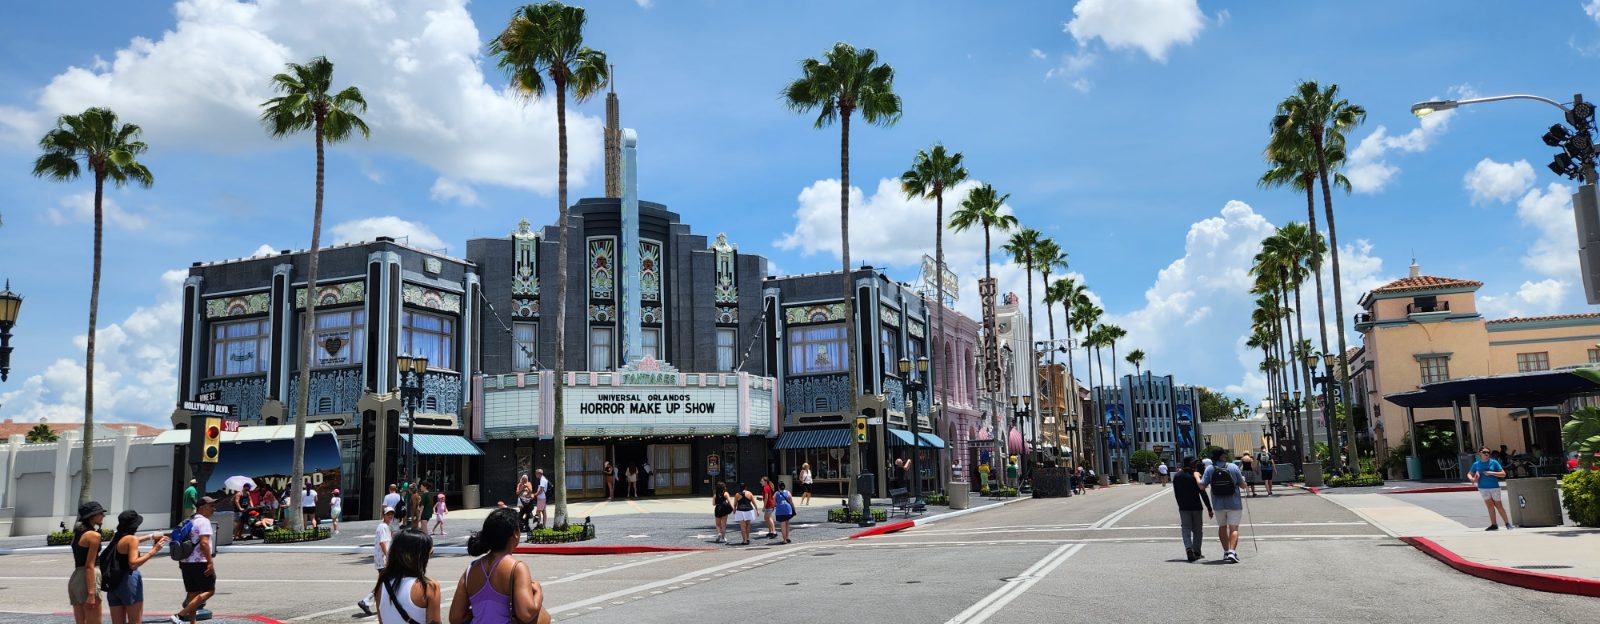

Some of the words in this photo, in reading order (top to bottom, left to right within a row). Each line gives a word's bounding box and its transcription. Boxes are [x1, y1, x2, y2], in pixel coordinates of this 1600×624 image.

[598, 394, 641, 402] UNIVERSAL
[648, 394, 691, 402] ORLANDO'S
[184, 401, 215, 412] HOLLYWOOD
[215, 404, 230, 414] BLVD.
[580, 402, 625, 415] HORROR
[630, 402, 662, 415] MAKE
[666, 402, 680, 415] UP
[685, 402, 715, 415] SHOW
[225, 420, 239, 431] STOP
